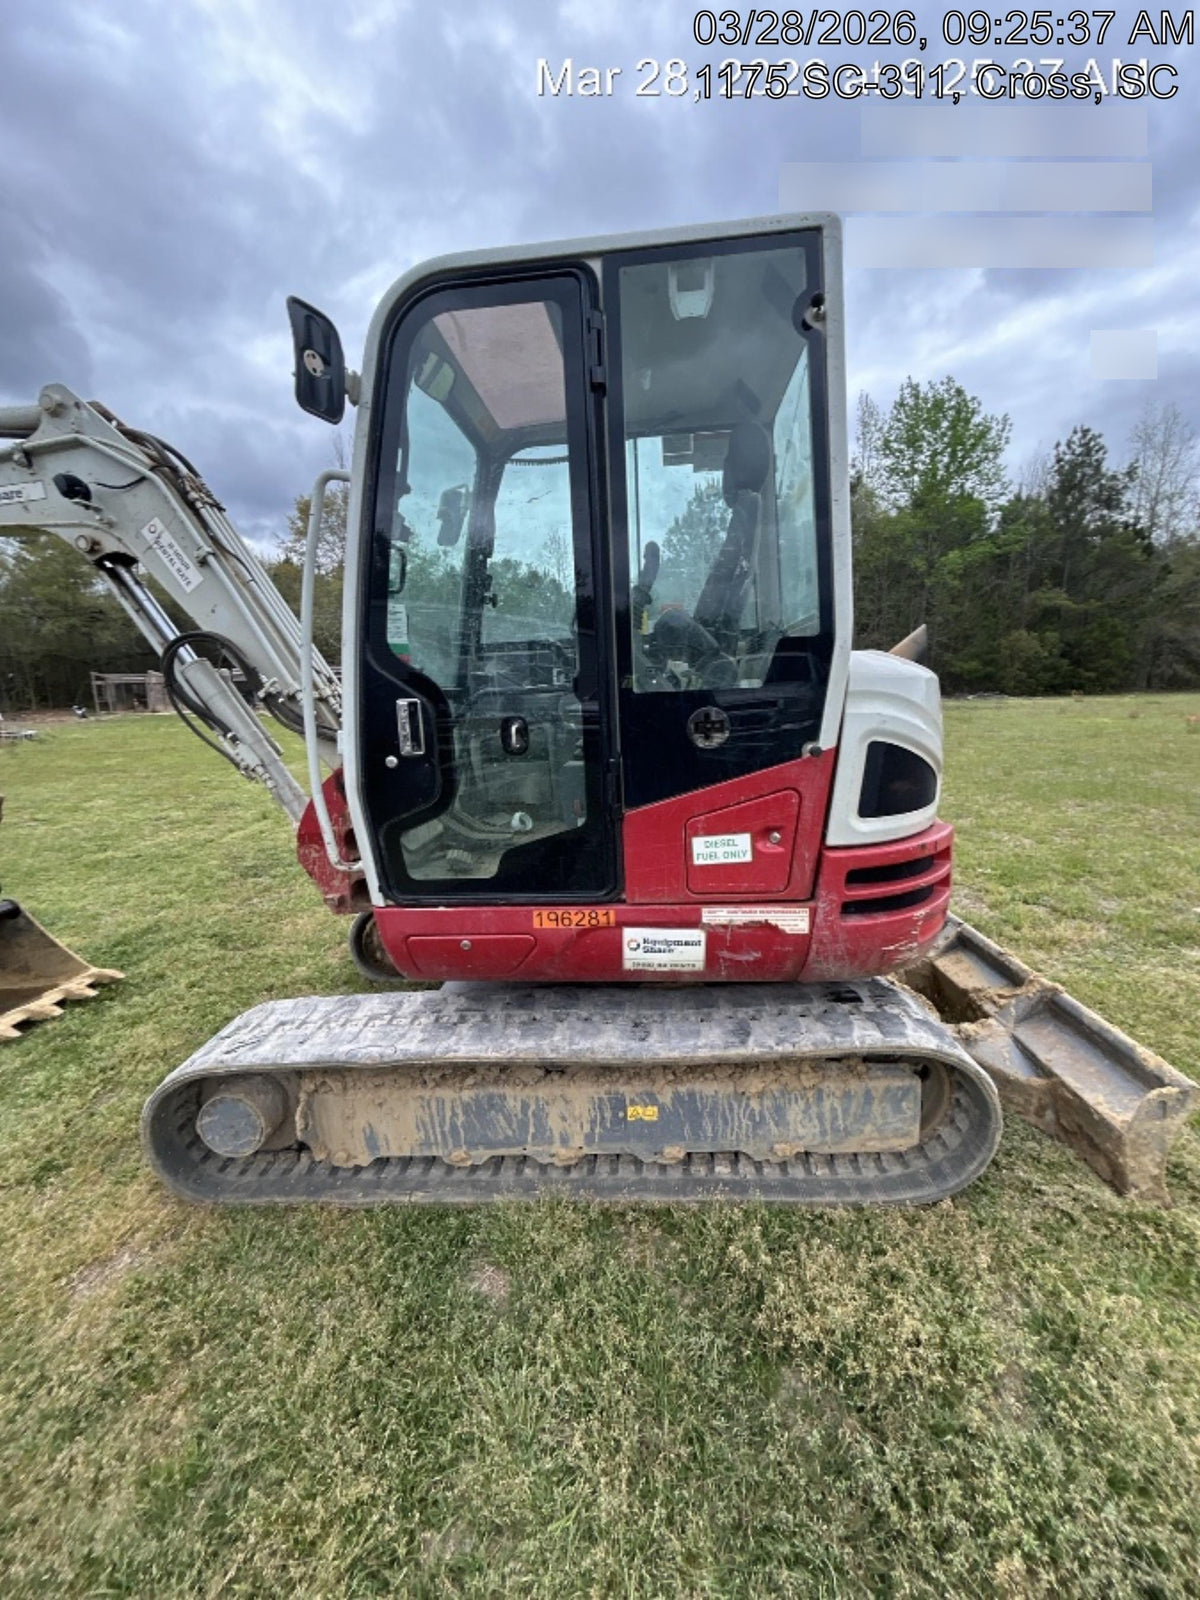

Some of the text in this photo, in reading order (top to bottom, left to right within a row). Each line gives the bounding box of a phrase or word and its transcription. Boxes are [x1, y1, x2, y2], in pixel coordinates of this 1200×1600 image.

[703, 838, 739, 849] DIESEL
[696, 849, 748, 861] FUEL ONLY
[534, 911, 611, 927] 196281
[643, 937, 702, 947] Equipment
